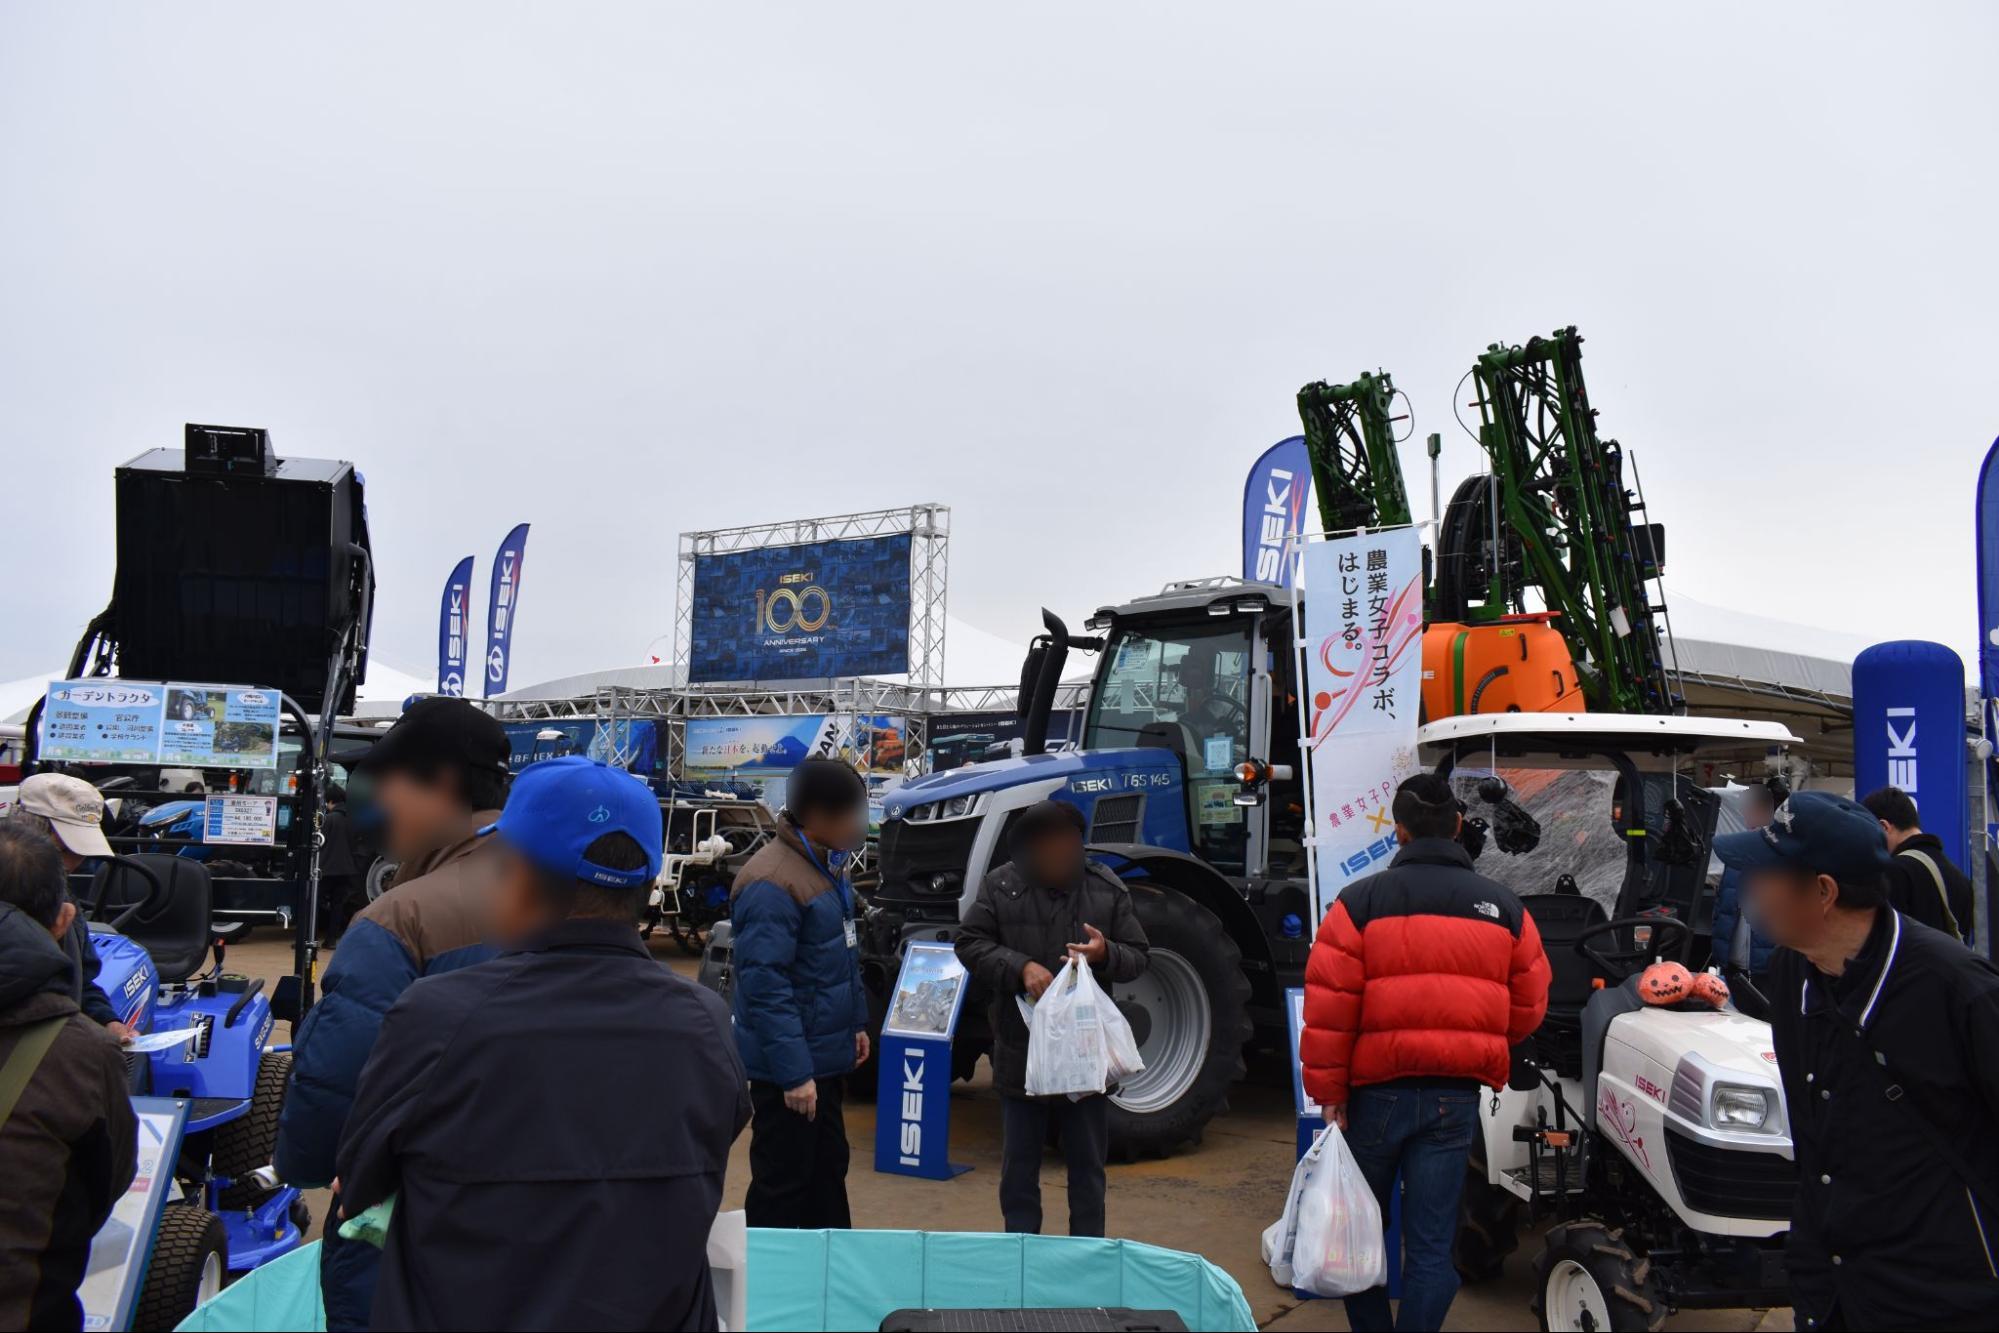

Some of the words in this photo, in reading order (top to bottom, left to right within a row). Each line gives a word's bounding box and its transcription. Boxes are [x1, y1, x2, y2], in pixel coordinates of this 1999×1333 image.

[1255, 468, 1293, 582] SEKI
[494, 551, 515, 639] ISEKI
[780, 572, 813, 584] ISEKI
[1338, 552, 1362, 651] はじまる。
[448, 584, 463, 666] ISEKI
[755, 585, 830, 635] 100
[764, 636, 825, 646] ANNIVERSARY
[1366, 549, 1396, 720] 農業女子コラボ、
[59, 689, 151, 704] ガーデントラクタ
[1886, 707, 1918, 790] EKI
[1071, 778, 1113, 793] ISEKI
[1150, 773, 1170, 786] 145
[594, 871, 628, 885] ISEKI
[1340, 831, 1399, 877] ISEK
[123, 964, 149, 999] ISEKI
[900, 1047, 925, 1168] ISEKI
[1635, 1074, 1666, 1103] ISEKI
